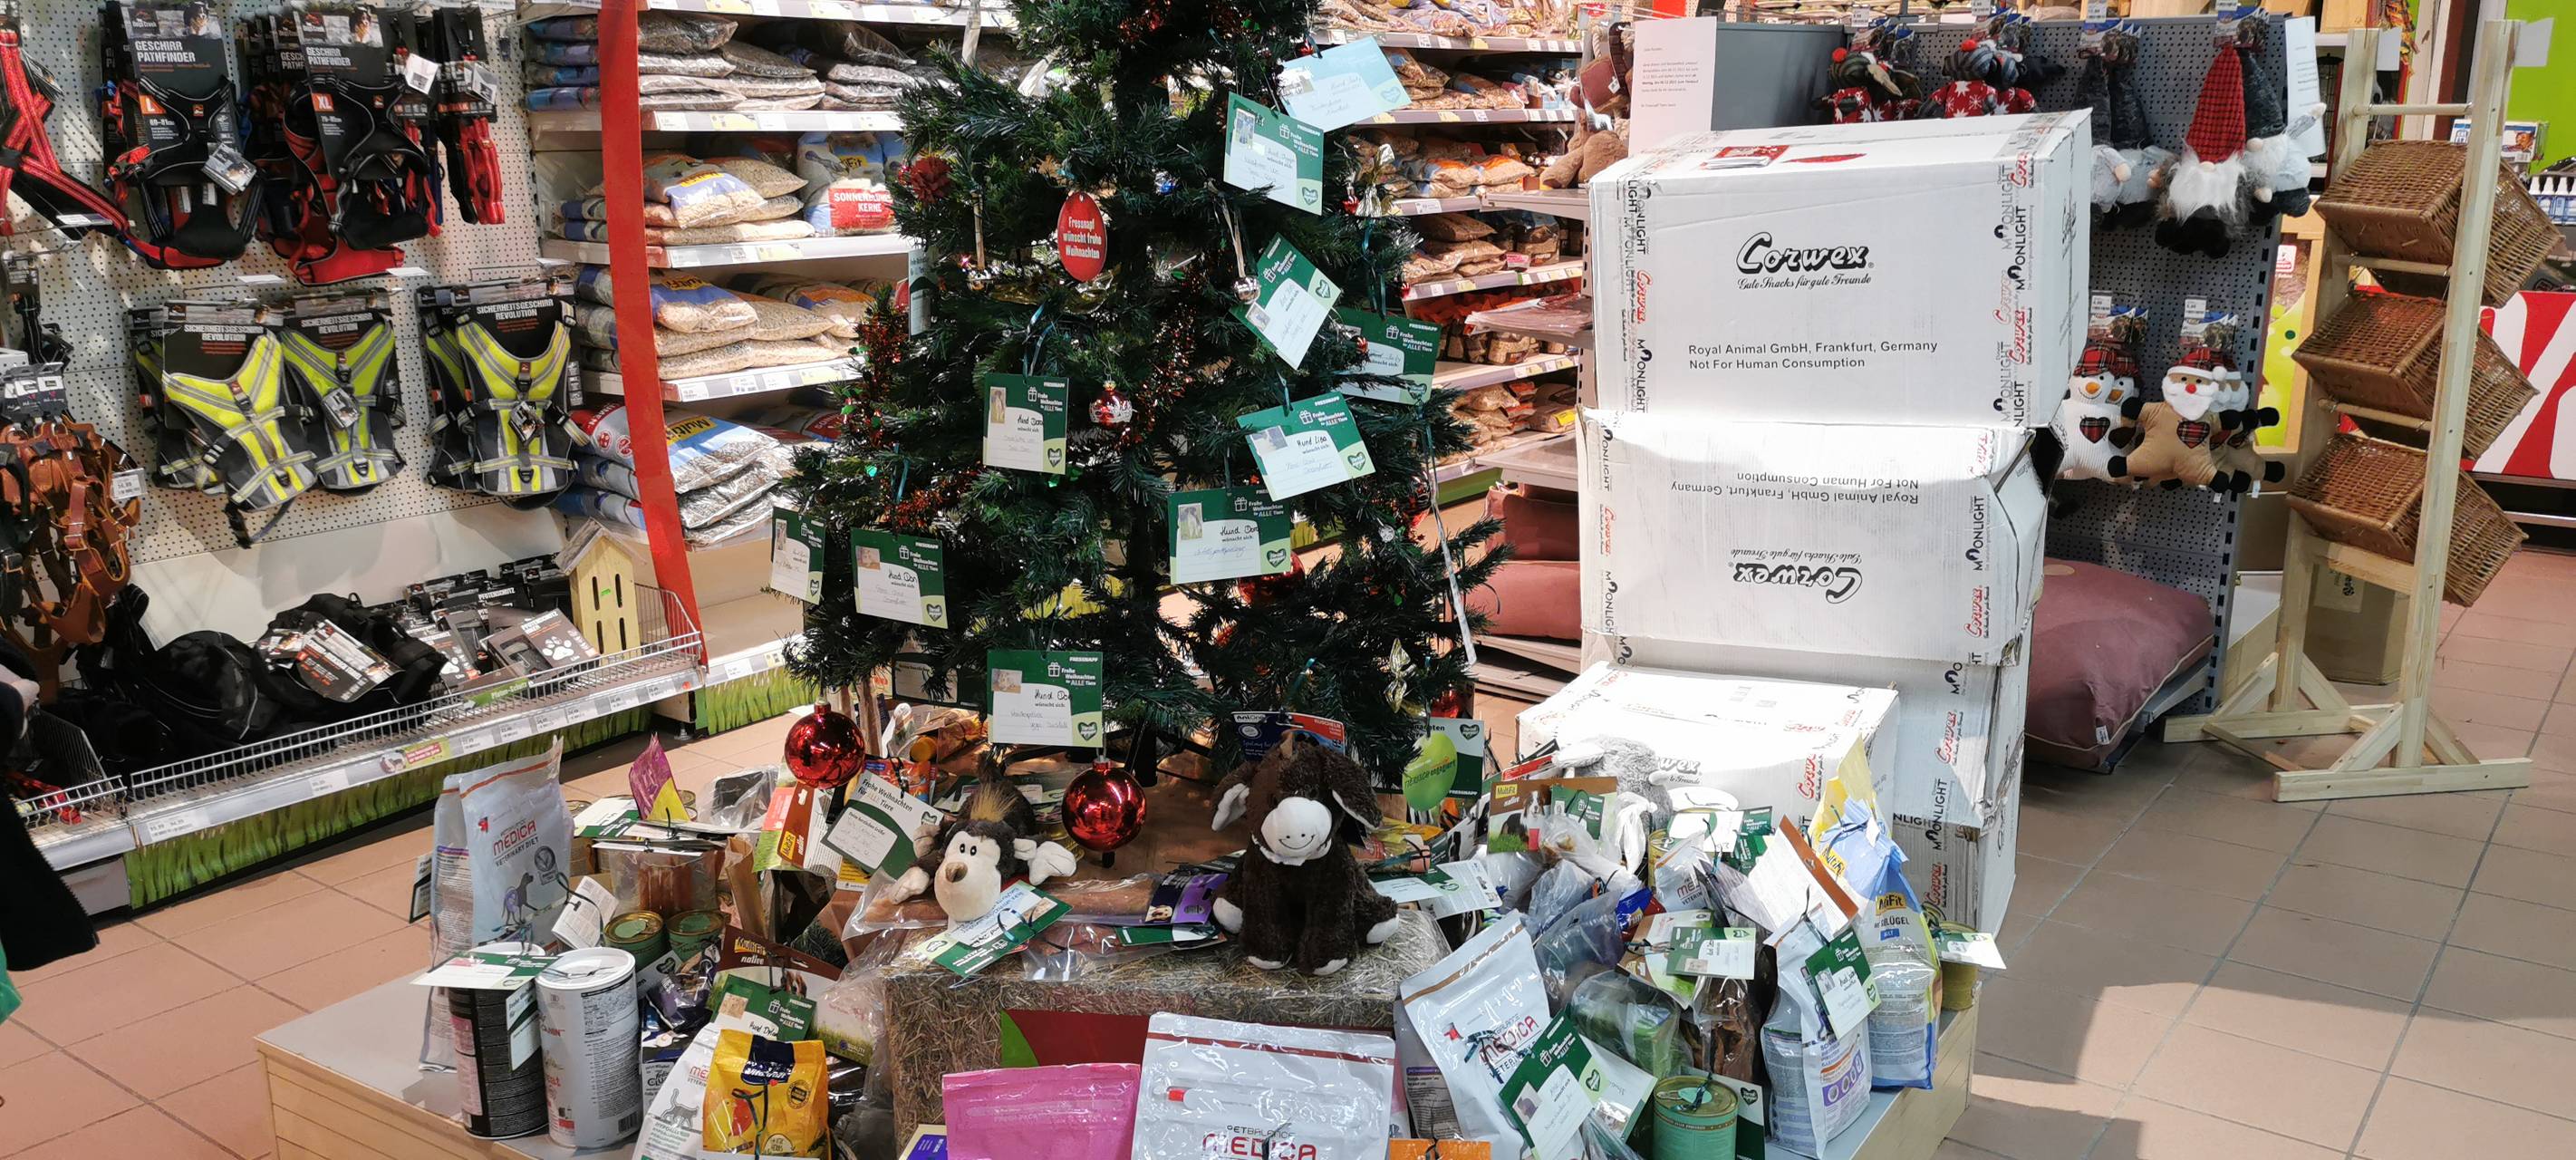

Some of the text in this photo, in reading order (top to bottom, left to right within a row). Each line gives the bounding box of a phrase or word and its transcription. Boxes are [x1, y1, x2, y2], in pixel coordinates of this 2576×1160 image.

[135, 40, 183, 52] GESCHIRR
[137, 52, 197, 63] PATHFINDER
[317, 93, 333, 111] XL
[857, 203, 883, 213] KERNE
[1066, 246, 1100, 259] Weihnachten
[1736, 231, 1868, 274] Corwex
[1737, 276, 1760, 290] Gute
[1760, 276, 1795, 288] Snacks
[1808, 277, 1830, 290] gute
[1830, 273, 1872, 285] Freunde
[1636, 269, 1653, 325] Corwex
[476, 298, 555, 315] SICHERHEITSGESCHIRR
[495, 308, 538, 321] REVOLUTION
[2008, 309, 2025, 364] Corwex
[1688, 341, 1938, 357] Royal Animal GmbH, Frankfurt, Germany
[1689, 357, 1866, 370] Not For Human Consumption
[1736, 471, 1919, 490] Not For Human Consumption
[1670, 480, 1919, 505] Royal Animal GmbH, Frankfurt, Germany
[1734, 562, 1863, 604] Corwex
[1964, 585, 1983, 637] Corwex
[1934, 710, 1957, 764] Corwex
[862, 778, 913, 812] Frohe Weihnachten
[879, 799, 894, 812] Tiere
[493, 819, 536, 856] MEDICA
[740, 954, 765, 966] native
